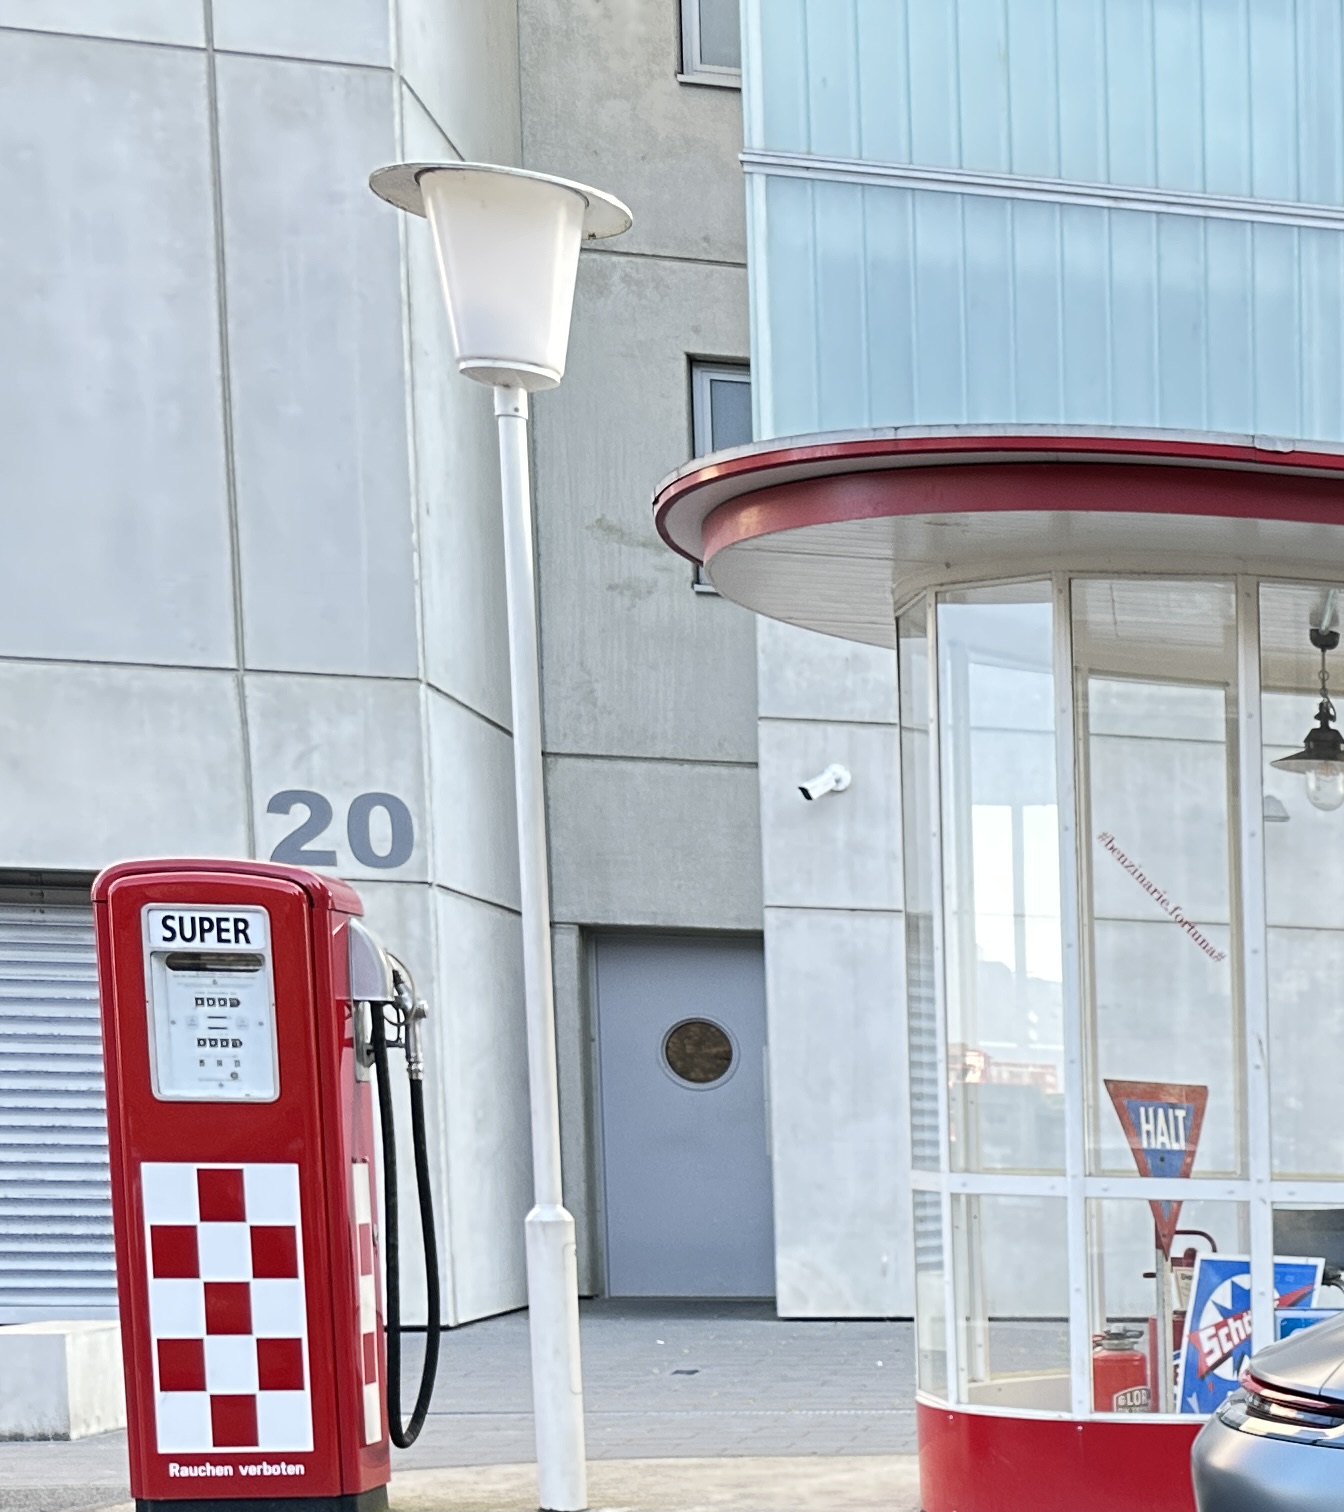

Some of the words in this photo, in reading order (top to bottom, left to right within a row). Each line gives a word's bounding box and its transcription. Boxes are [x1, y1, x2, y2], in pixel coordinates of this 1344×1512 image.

[266, 789, 415, 869] 20
[161, 914, 251, 944] SUPER
[1140, 1106, 1187, 1150] HALT
[168, 1462, 234, 1477] Rauchen
[238, 1461, 305, 1476] verboten
